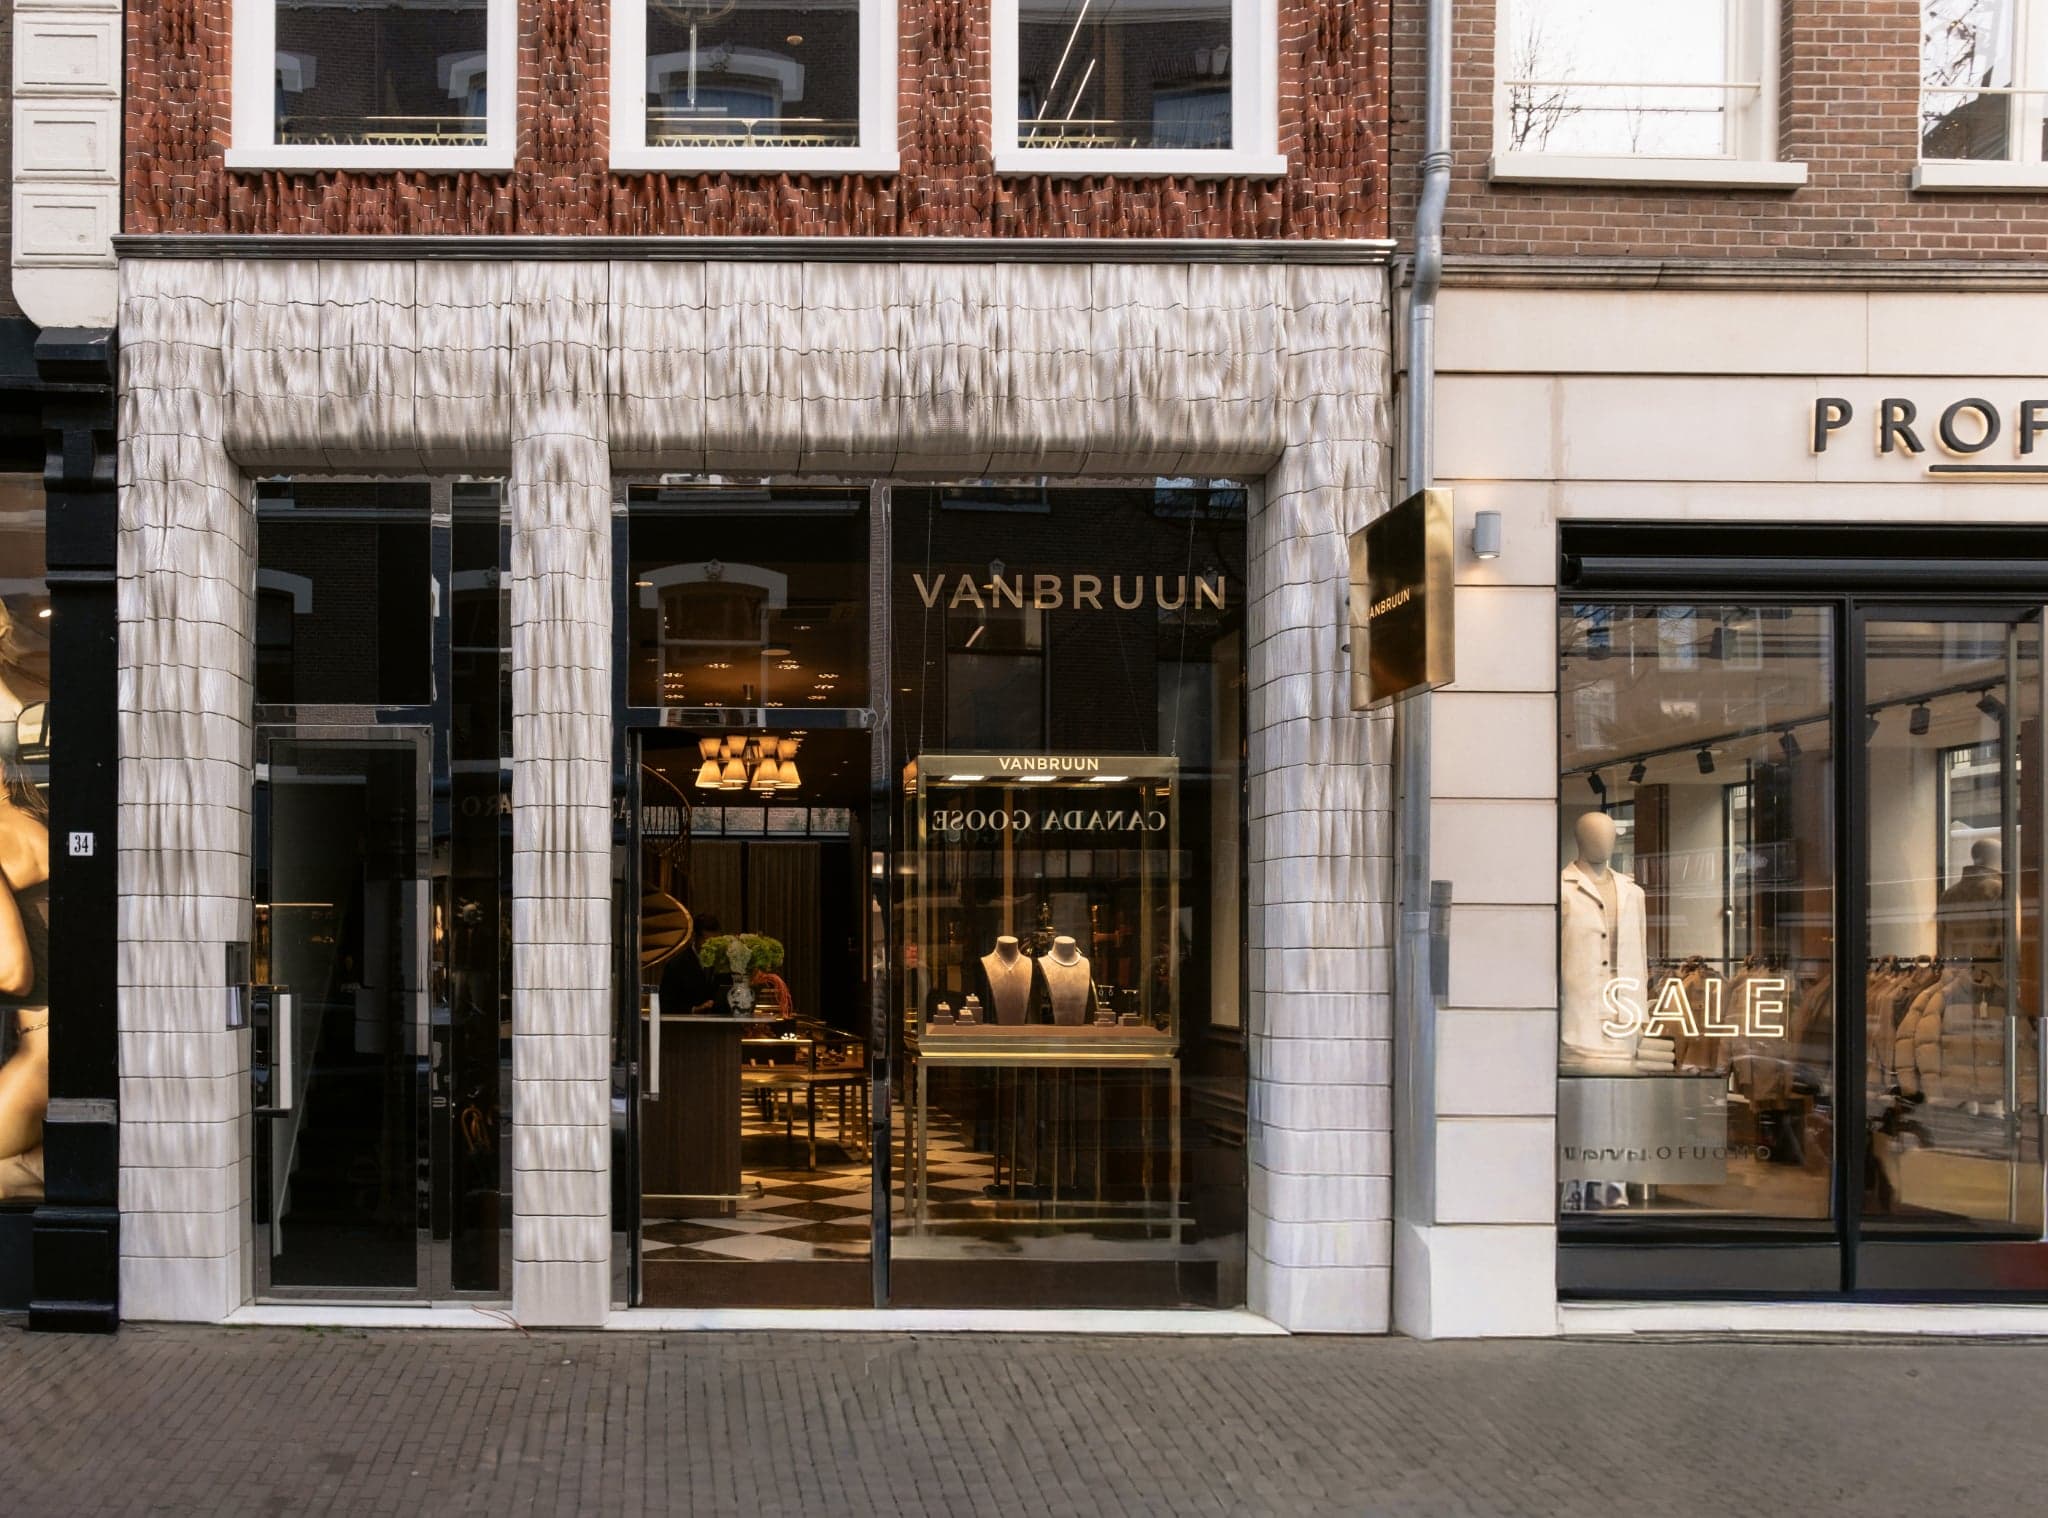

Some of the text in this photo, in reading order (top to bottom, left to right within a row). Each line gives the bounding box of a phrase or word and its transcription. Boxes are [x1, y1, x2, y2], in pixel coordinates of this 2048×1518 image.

[1809, 396, 2048, 458] PROF
[912, 573, 1227, 611] VANBRUUN
[1367, 588, 1410, 620] ANBRUUN
[998, 757, 1100, 772] VANBRUUN
[73, 834, 90, 853] 34
[1601, 978, 1787, 1038] SALE
